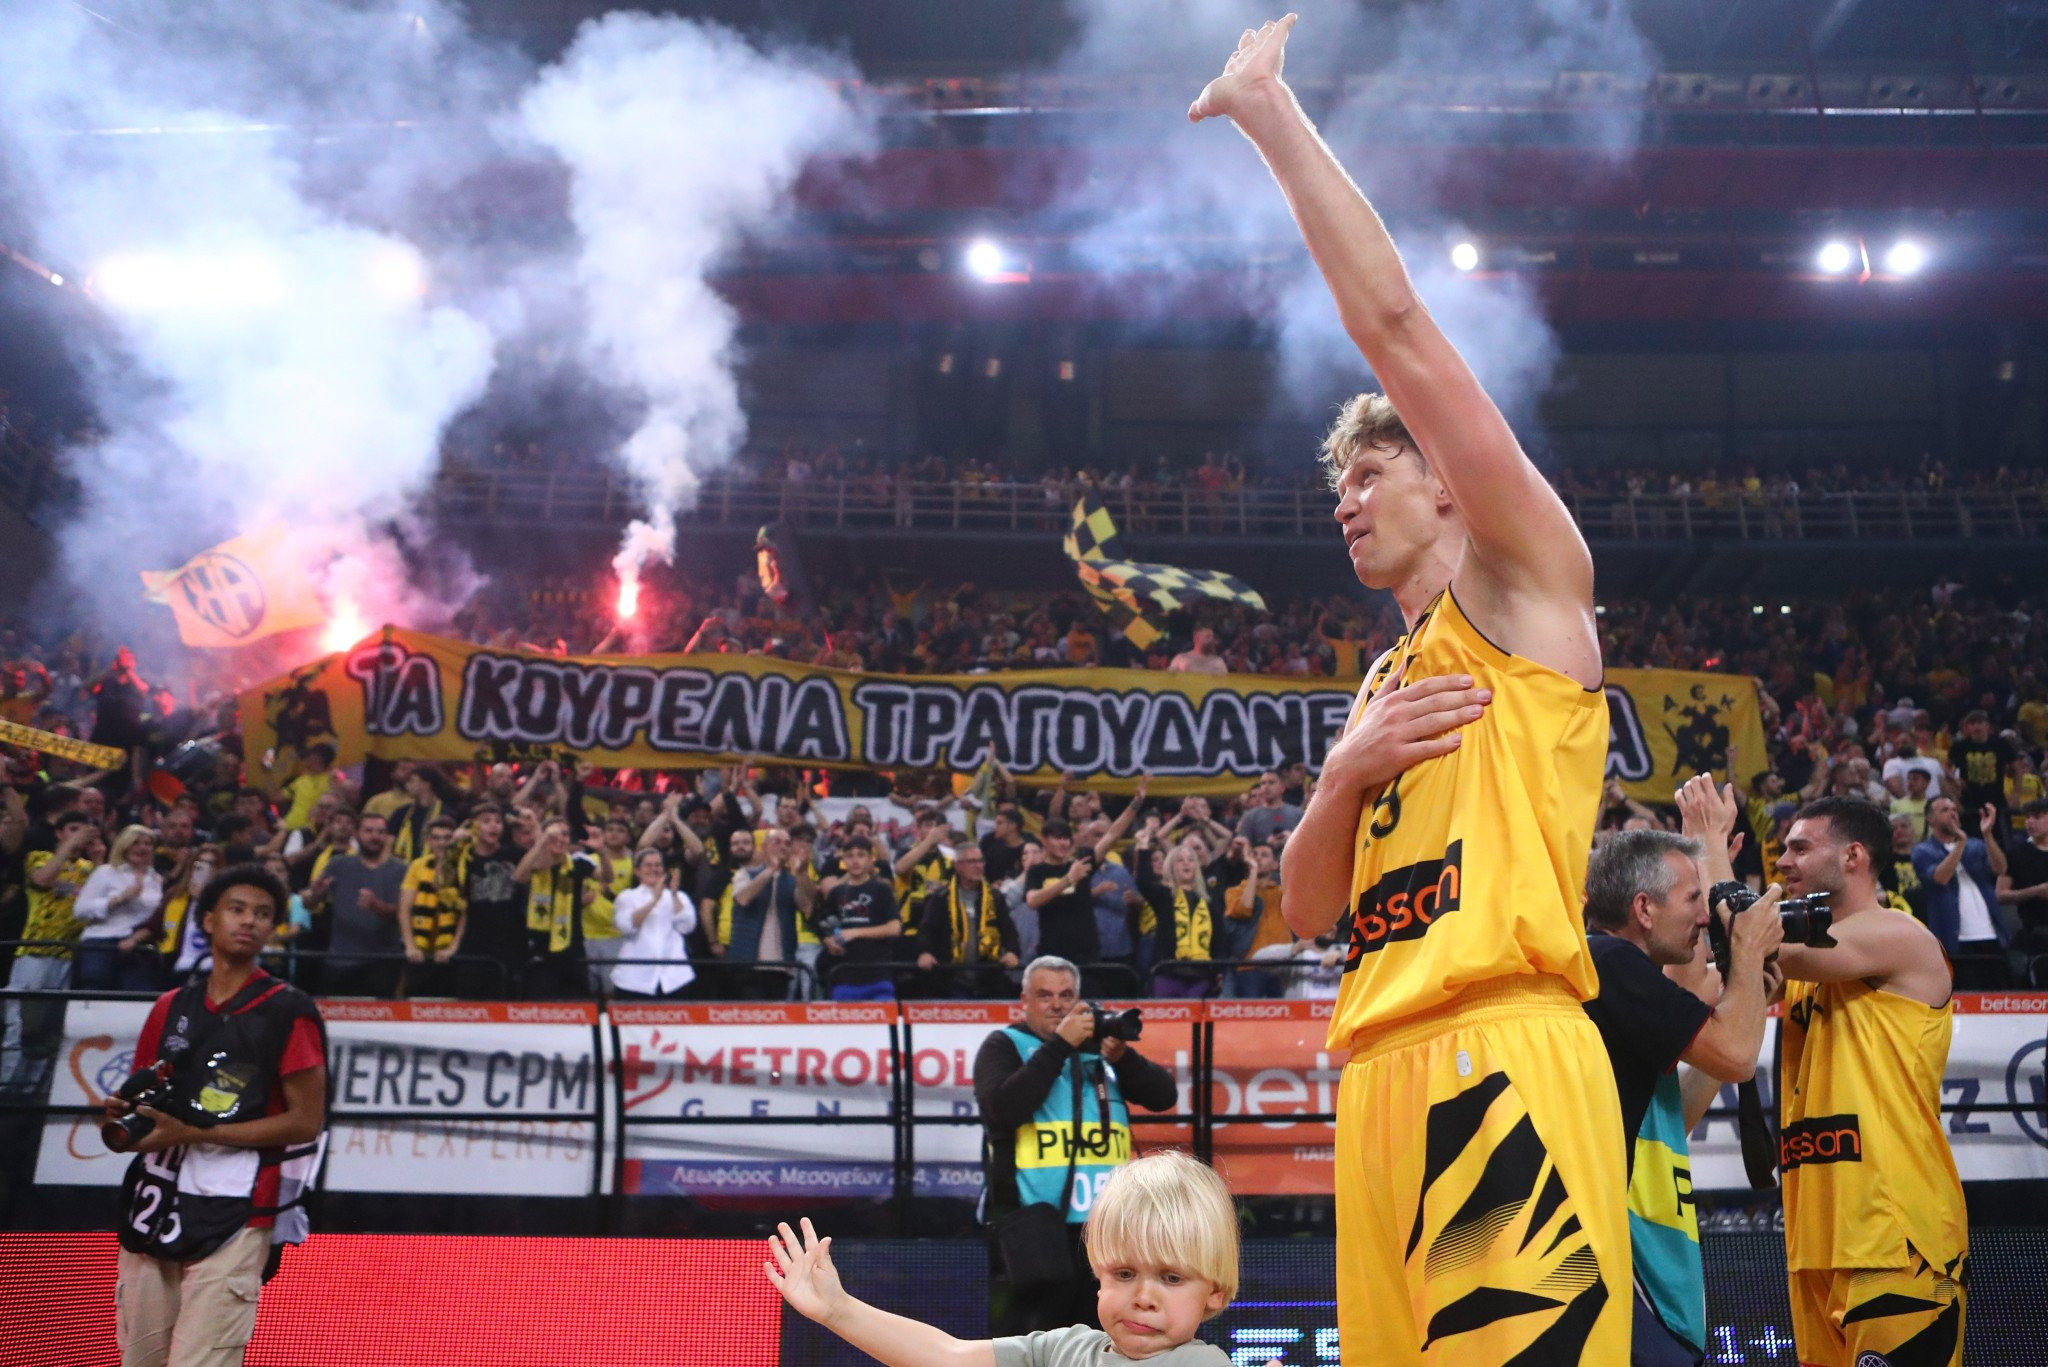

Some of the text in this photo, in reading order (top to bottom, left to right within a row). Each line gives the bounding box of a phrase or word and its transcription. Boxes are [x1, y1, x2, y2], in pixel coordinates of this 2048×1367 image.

[457, 652, 849, 763] ΚΟΥΡΕΛΙΑ
[410, 1004, 489, 1020] betsson
[507, 1005, 586, 1020] betsson
[612, 1006, 885, 1022] betsson betsson betsson
[908, 1006, 988, 1021] betsson
[1210, 1005, 1290, 1018] betsson
[485, 1050, 591, 1110] CPM
